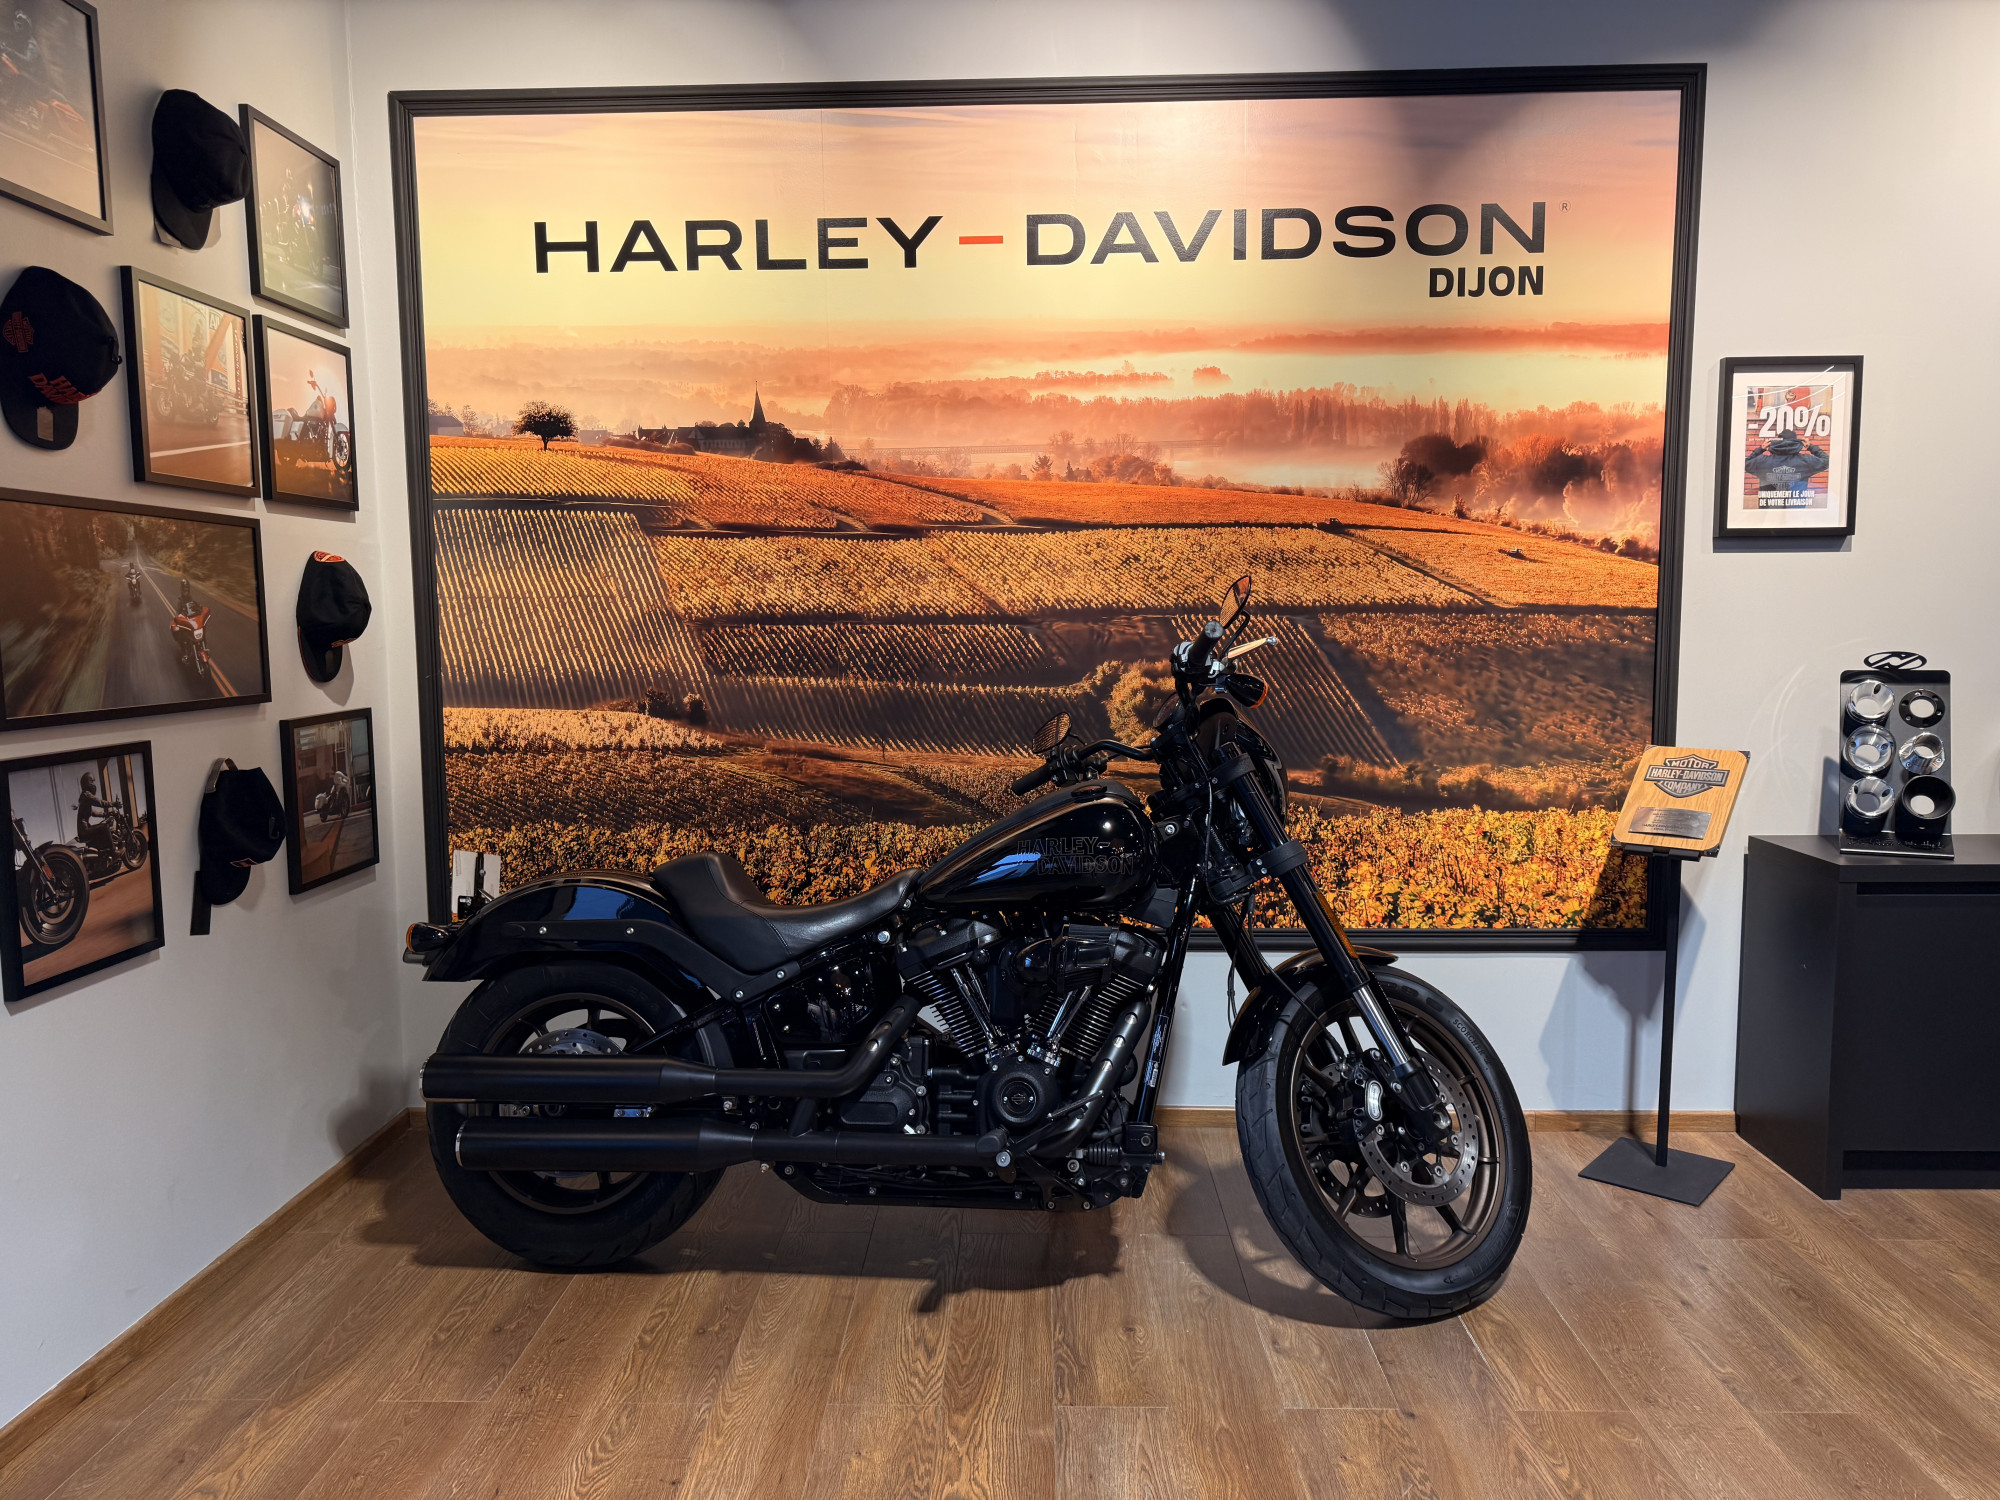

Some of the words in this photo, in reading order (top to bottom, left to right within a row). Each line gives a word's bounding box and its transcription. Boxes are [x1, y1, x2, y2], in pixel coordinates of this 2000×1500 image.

[1429, 265, 1544, 298] DIJON
[1747, 405, 1831, 437] -20%
[1757, 490, 1792, 498] UNIQUEMENT
[1793, 490, 1800, 498] LE
[1800, 490, 1815, 498] JOUR
[1759, 498, 1767, 506] DE
[1767, 498, 1785, 506] VOTRE
[1671, 757, 1709, 769] MOTOR
[1651, 767, 1724, 782] HARLEY-DAVIDSON
[1663, 780, 1703, 794] COMPANY
[1036, 855, 1135, 876] DAVIDSON
